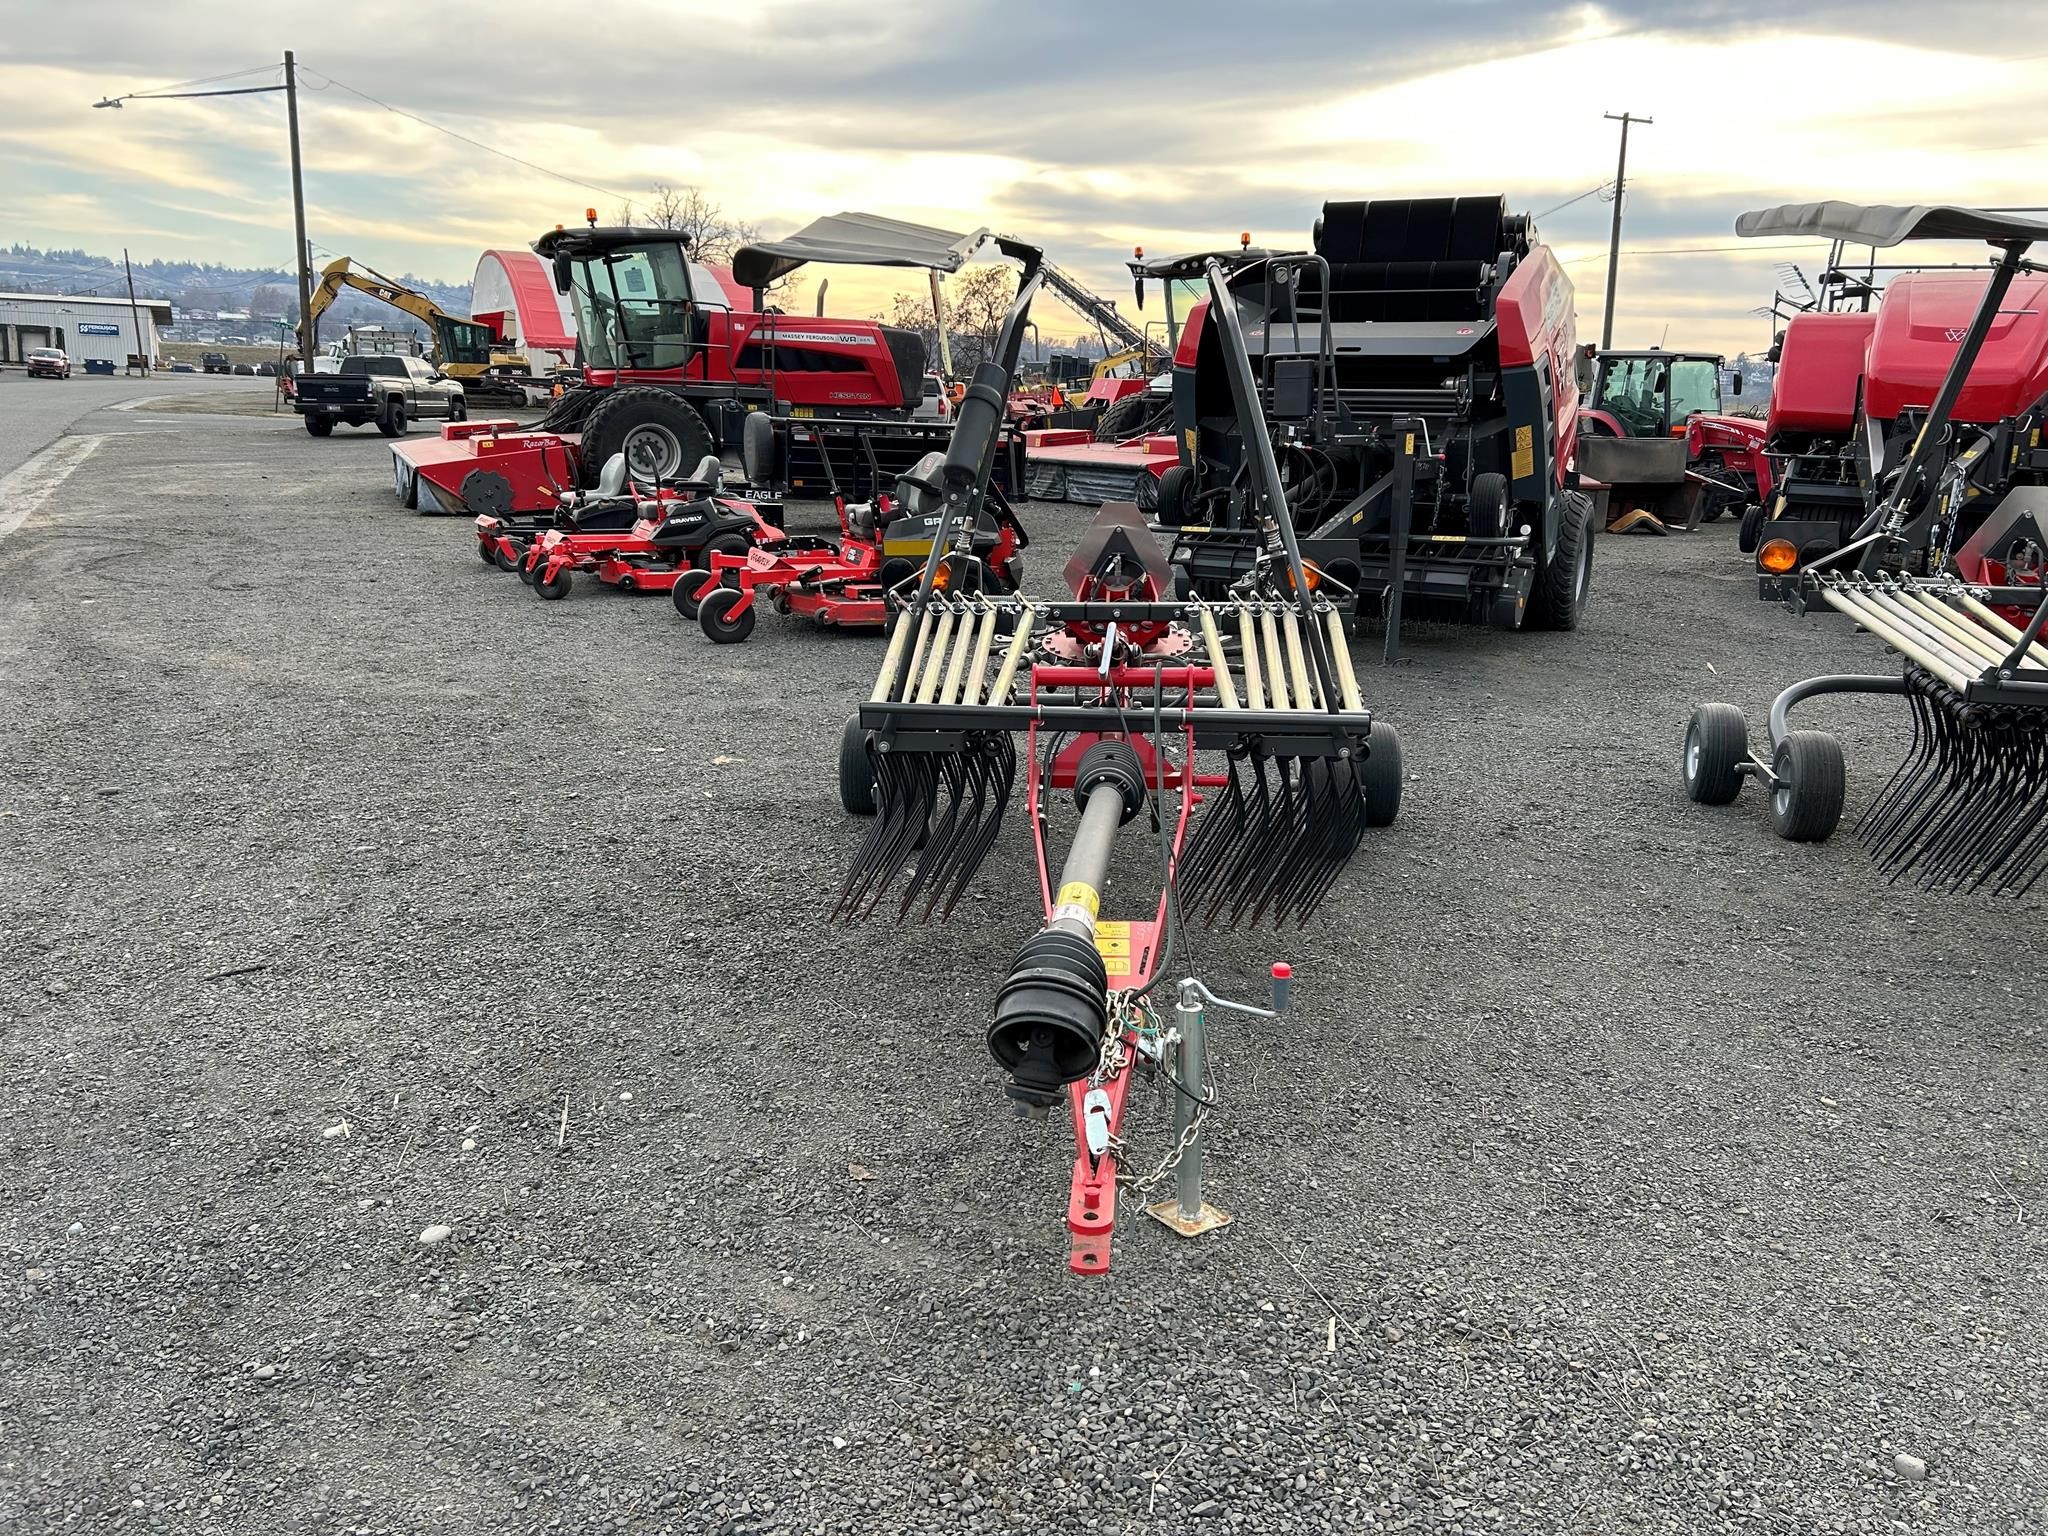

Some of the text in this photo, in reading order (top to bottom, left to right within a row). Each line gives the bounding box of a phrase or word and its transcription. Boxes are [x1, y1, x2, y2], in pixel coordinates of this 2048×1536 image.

[379, 288, 392, 300] CAT
[839, 335, 857, 343] WR
[745, 490, 782, 500] EAGLE
[670, 515, 702, 524] GRAVELY
